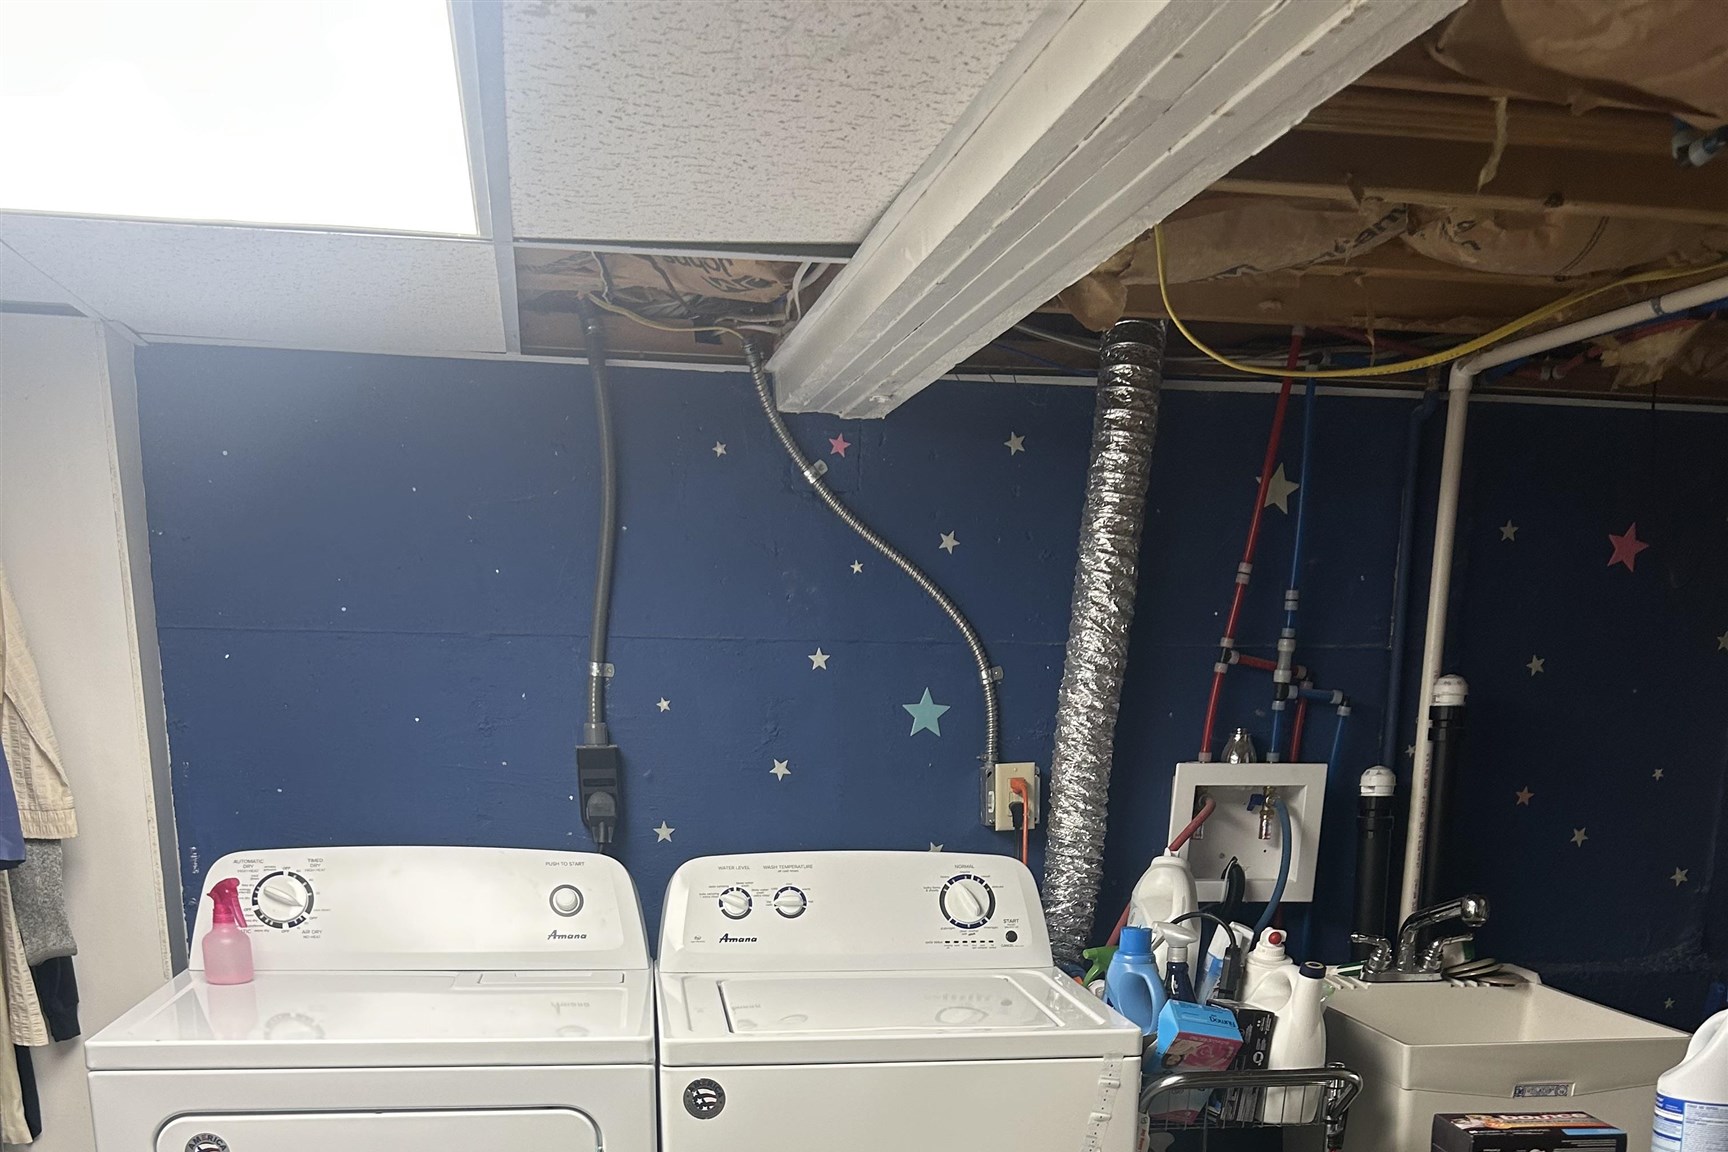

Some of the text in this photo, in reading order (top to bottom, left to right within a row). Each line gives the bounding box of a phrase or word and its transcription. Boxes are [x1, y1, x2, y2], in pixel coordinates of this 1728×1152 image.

[547, 929, 587, 940] Amana
[718, 932, 758, 944] Amana
[1498, 1111, 1589, 1121] bounce
[188, 1134, 227, 1151] AMERICA
